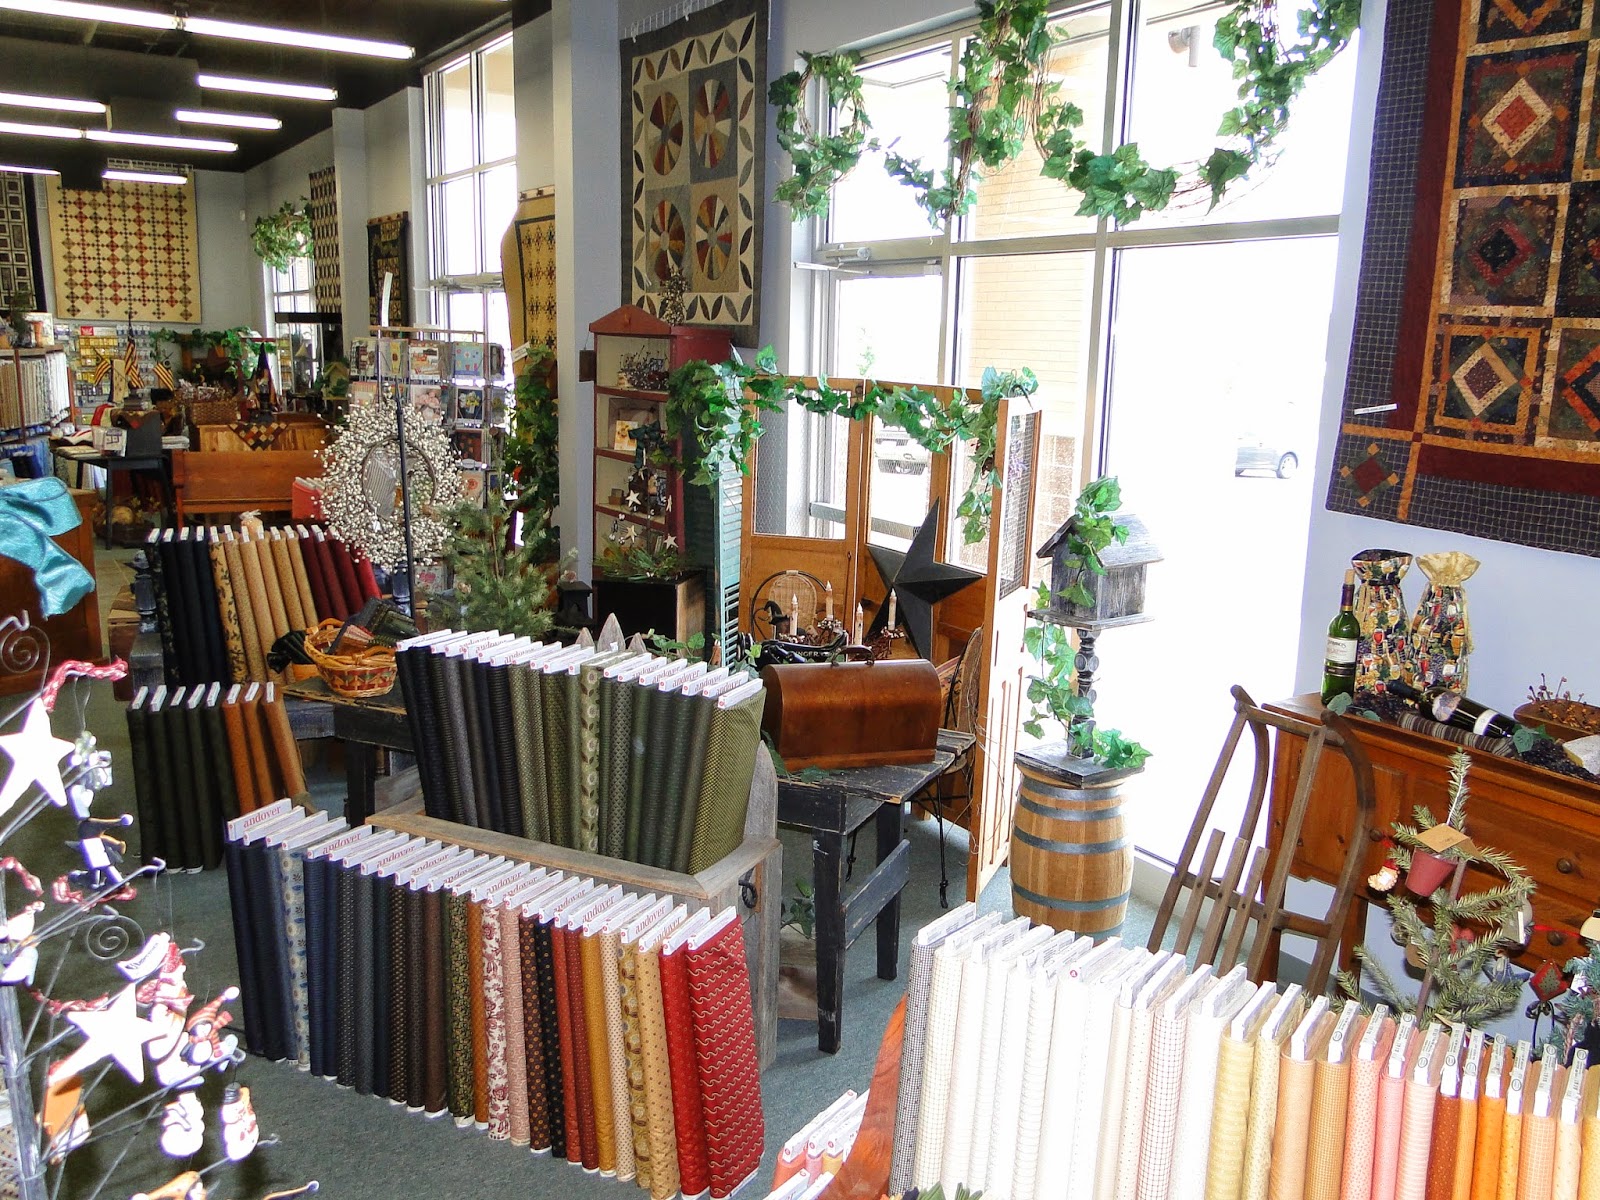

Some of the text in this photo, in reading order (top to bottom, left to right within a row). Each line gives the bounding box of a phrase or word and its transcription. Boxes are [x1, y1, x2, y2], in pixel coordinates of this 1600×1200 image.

[672, 670, 700, 687] andover
[716, 679, 741, 695] andover
[243, 806, 281, 828] andover
[323, 833, 361, 854] andover
[377, 845, 416, 868] andover
[487, 870, 522, 894] andover
[582, 894, 615, 922] andover
[635, 904, 666, 934] andover
